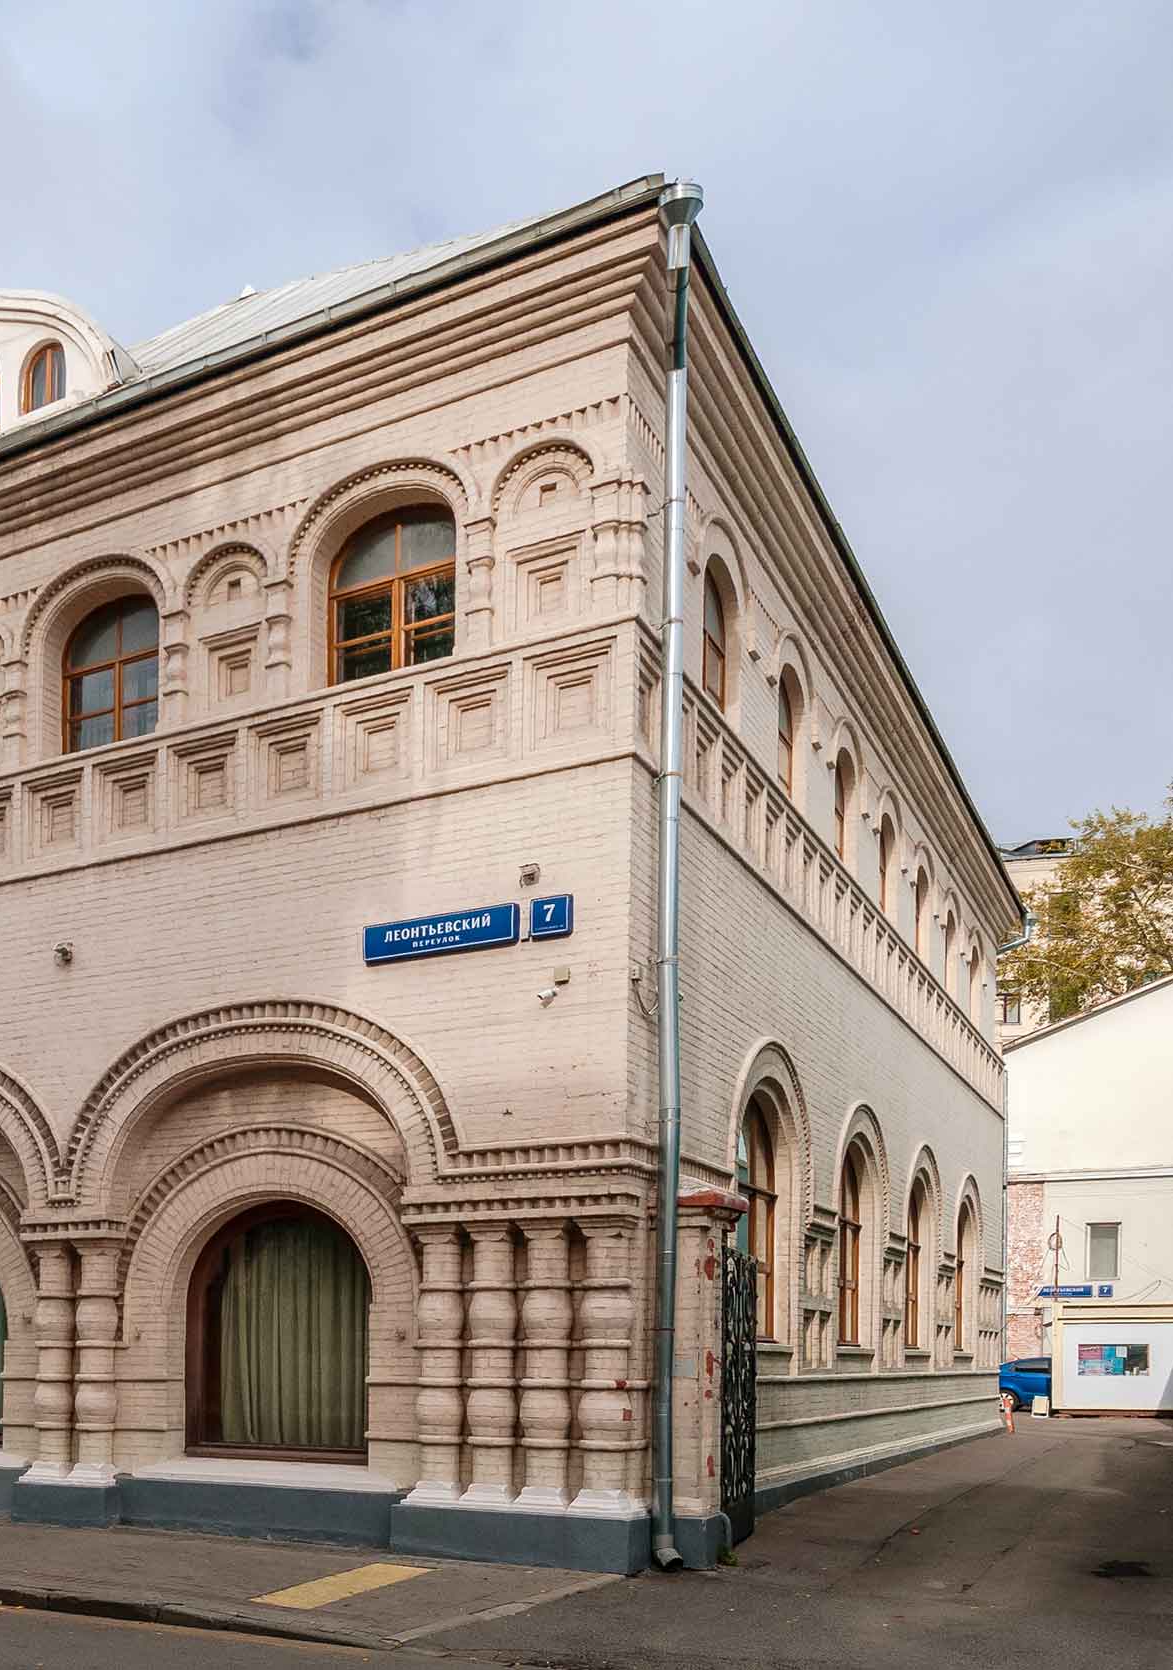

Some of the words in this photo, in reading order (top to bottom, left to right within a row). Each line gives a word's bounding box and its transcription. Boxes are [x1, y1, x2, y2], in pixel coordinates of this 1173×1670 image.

[543, 903, 556, 922] 7
[384, 913, 491, 943] ЛЕОНТЬЕВСКИЙ
[412, 935, 461, 949] ПЕРЕУЛОК
